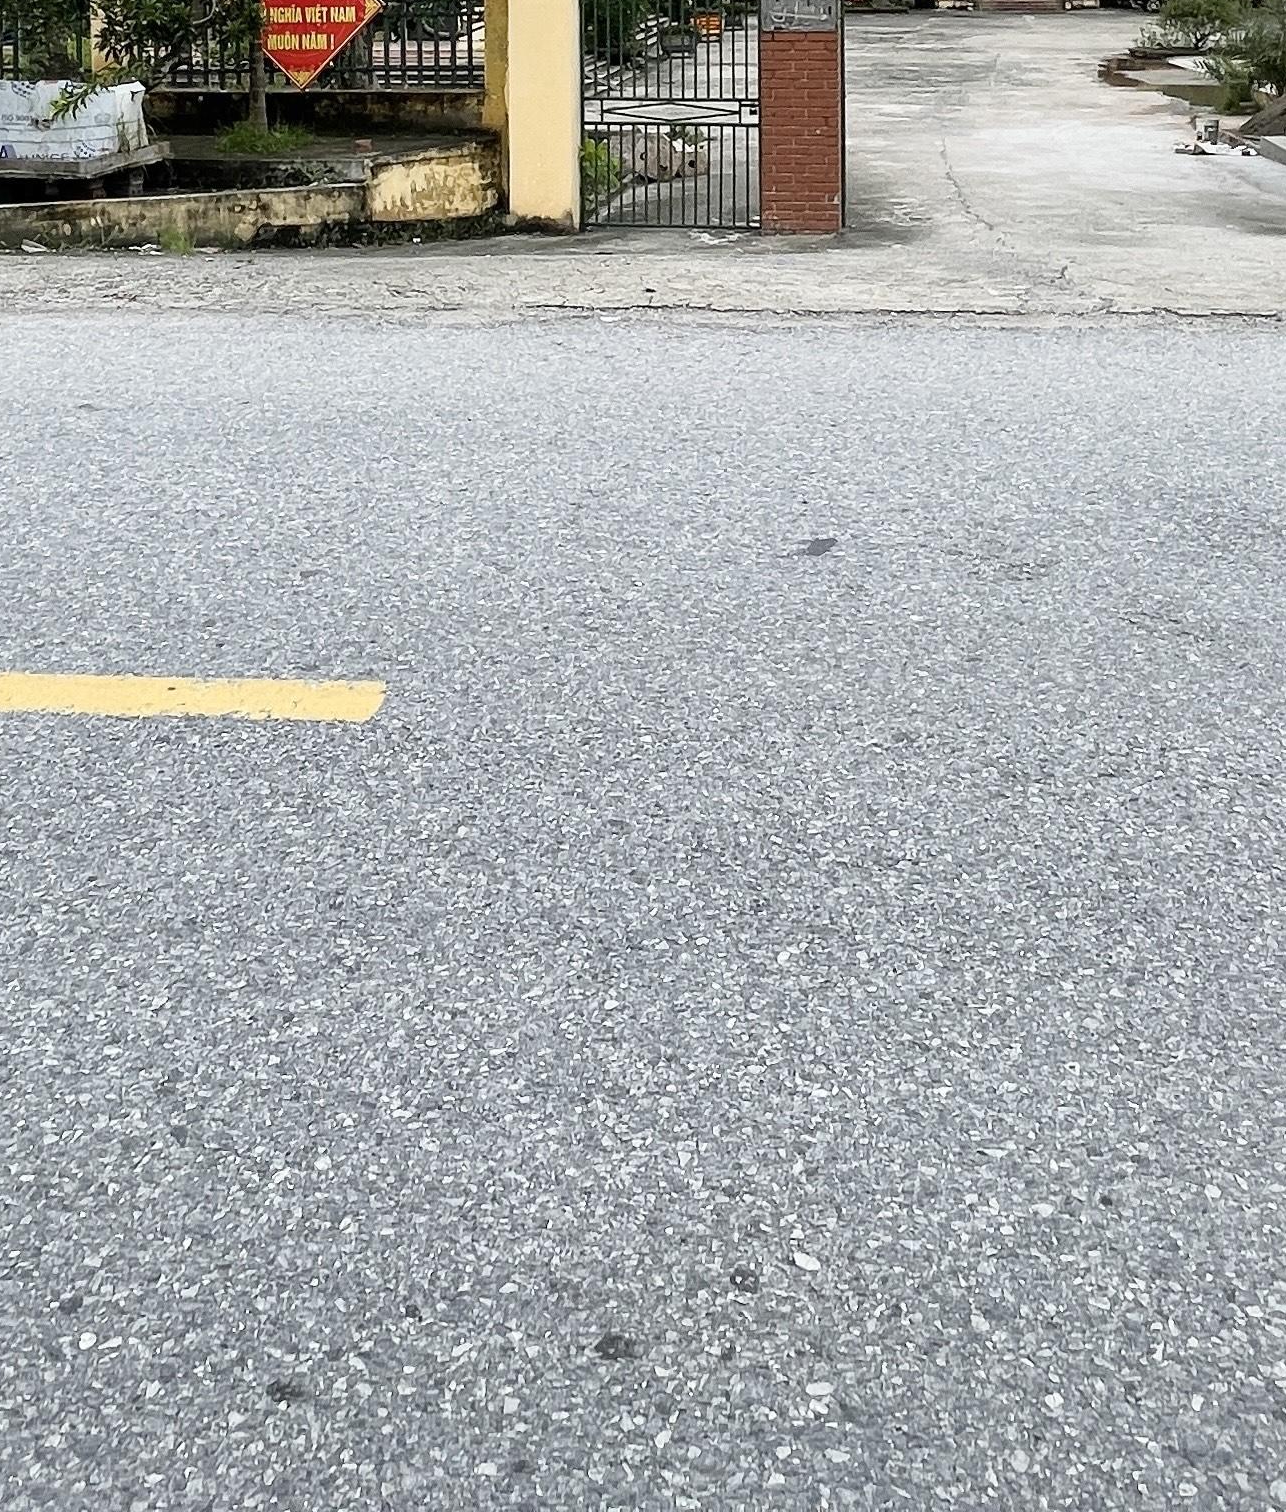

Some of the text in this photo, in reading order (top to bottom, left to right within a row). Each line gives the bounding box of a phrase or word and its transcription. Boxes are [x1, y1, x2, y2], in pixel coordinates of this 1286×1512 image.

[305, 3, 328, 26] VIỆT
[330, 6, 356, 22] NAM
[267, 31, 300, 50] MUÔN
[301, 31, 328, 50] NĂM
